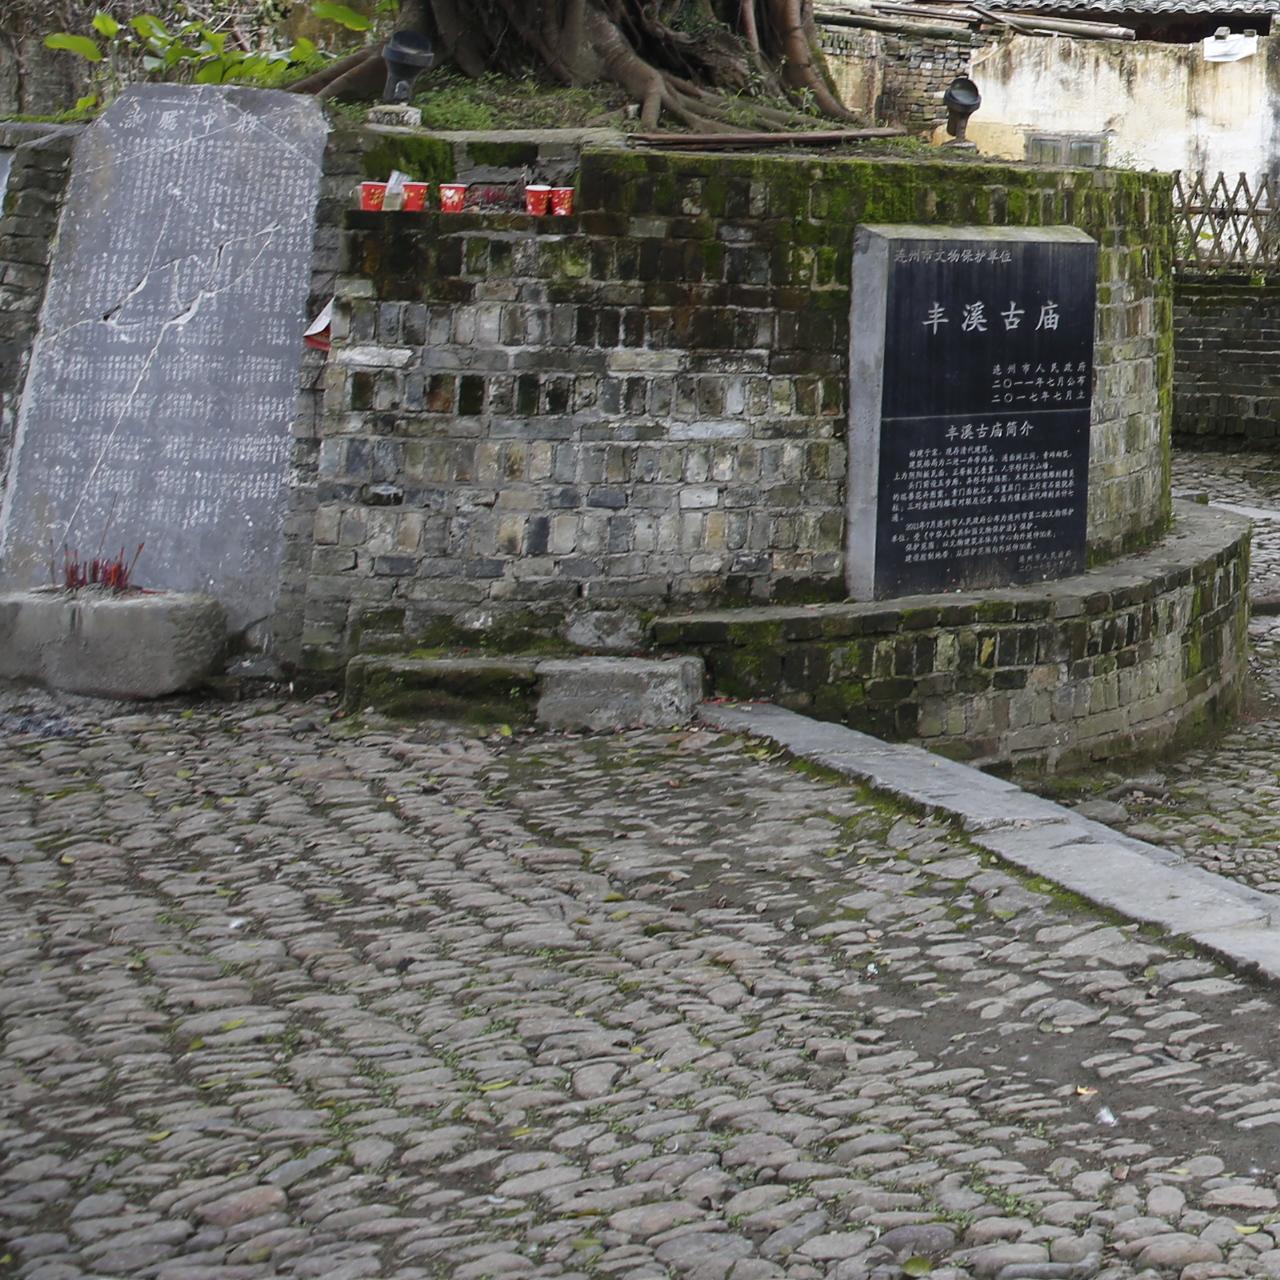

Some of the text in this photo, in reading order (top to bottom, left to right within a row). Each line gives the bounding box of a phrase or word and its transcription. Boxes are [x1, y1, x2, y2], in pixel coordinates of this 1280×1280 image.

[894, 248, 1012, 265] 连州市文物保护单位
[922, 300, 1060, 335] 丰溪古庙
[992, 361, 1087, 376] 连州市人民政府
[945, 420, 1034, 441] 丰溪古庙简介
